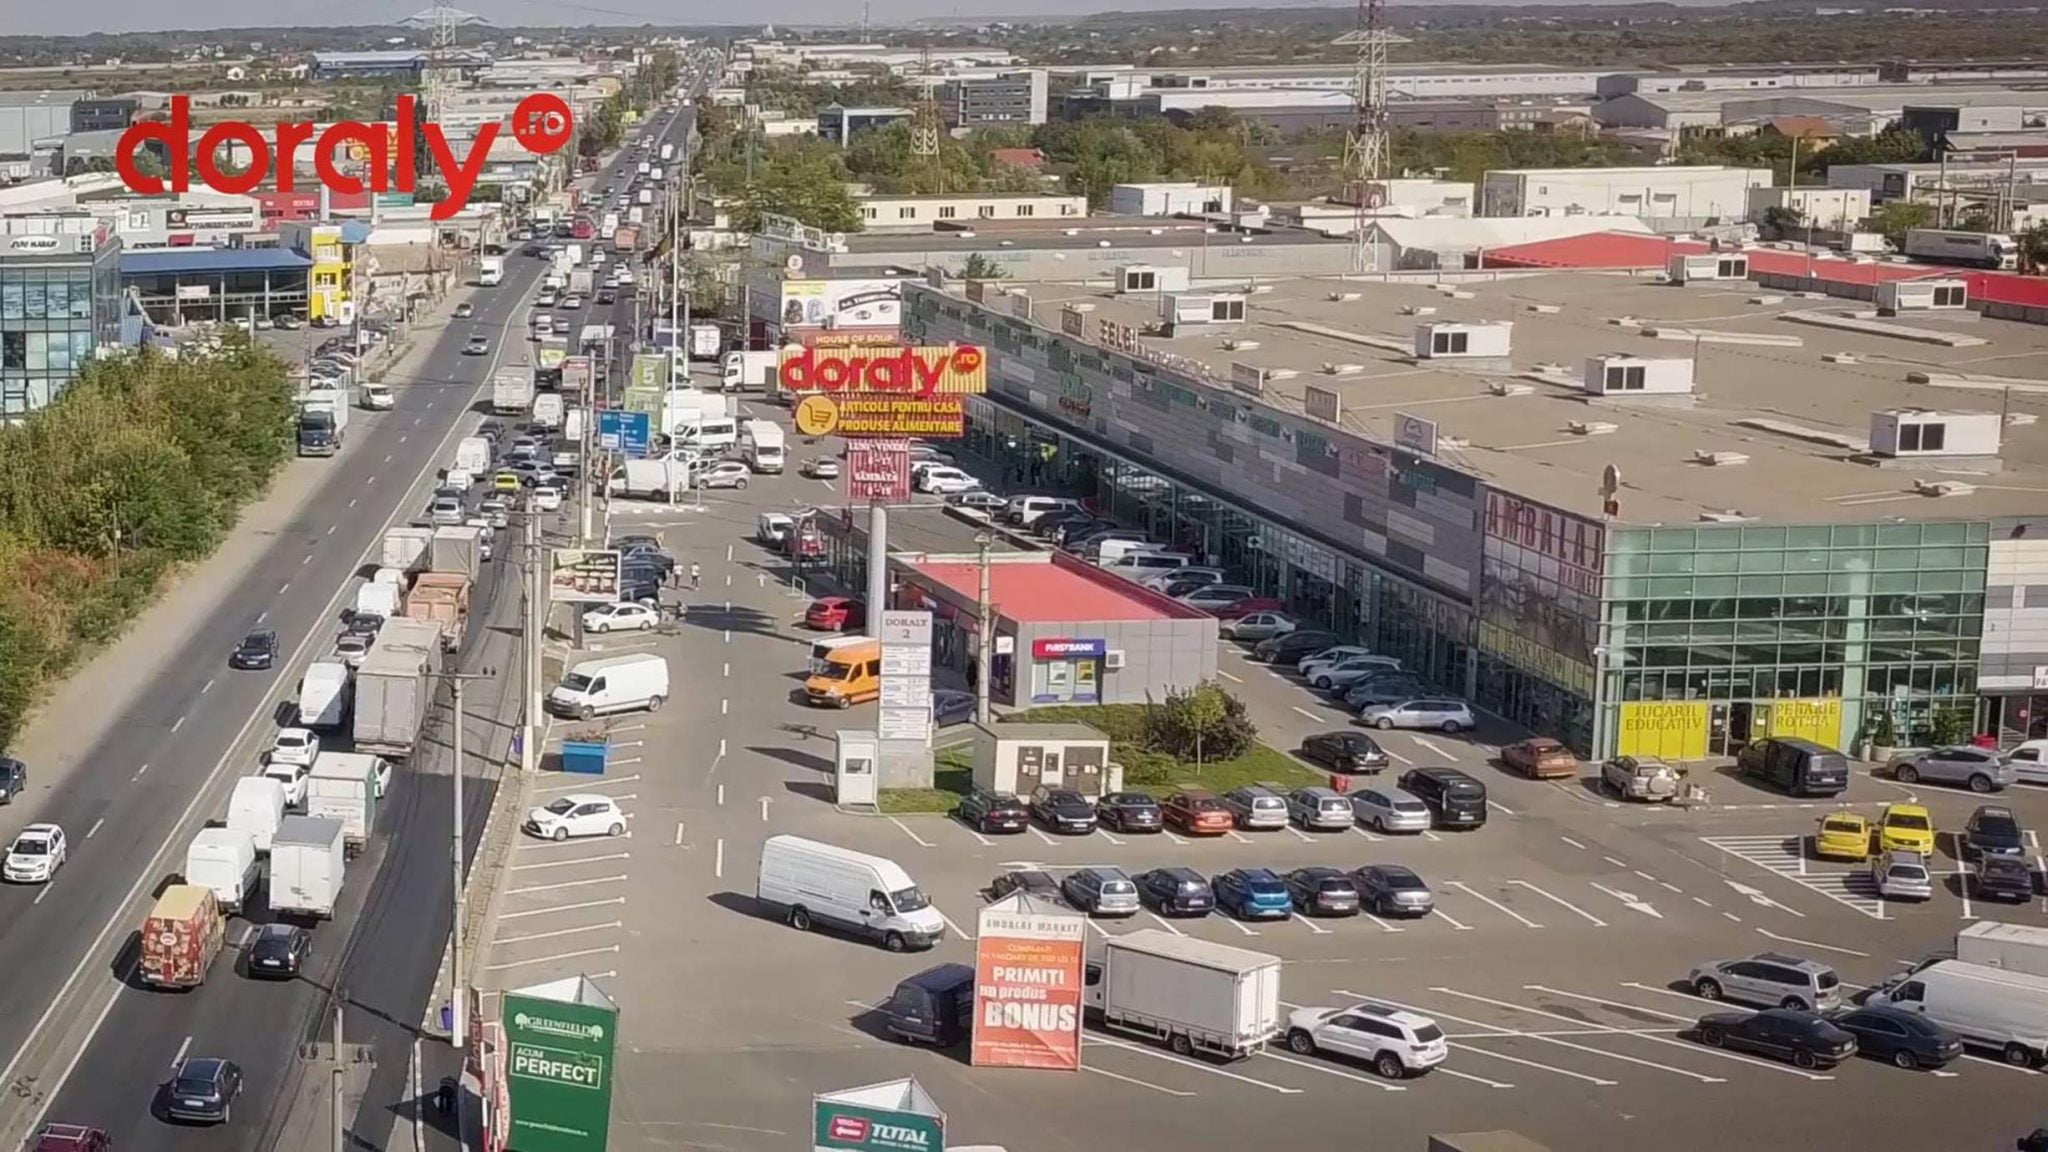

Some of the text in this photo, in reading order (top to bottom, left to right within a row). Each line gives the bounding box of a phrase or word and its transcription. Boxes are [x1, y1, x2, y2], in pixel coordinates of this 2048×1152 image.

[816, 336, 848, 344] HOUSE
[781, 348, 949, 398] doraly
[840, 401, 890, 413] ARTICOLE
[892, 401, 932, 413] PENTRU
[839, 420, 961, 432] PRODUSE ALIMENTARE
[1487, 492, 1601, 571] AMBALAJ
[998, 986, 1047, 1000] produs
[527, 1016, 592, 1034] GREENFIELD
[985, 1001, 1076, 1032] BONUS
[516, 1047, 544, 1058] ACUM
[515, 1056, 597, 1083] PERFECT
[872, 1122, 929, 1145] TOTAL
